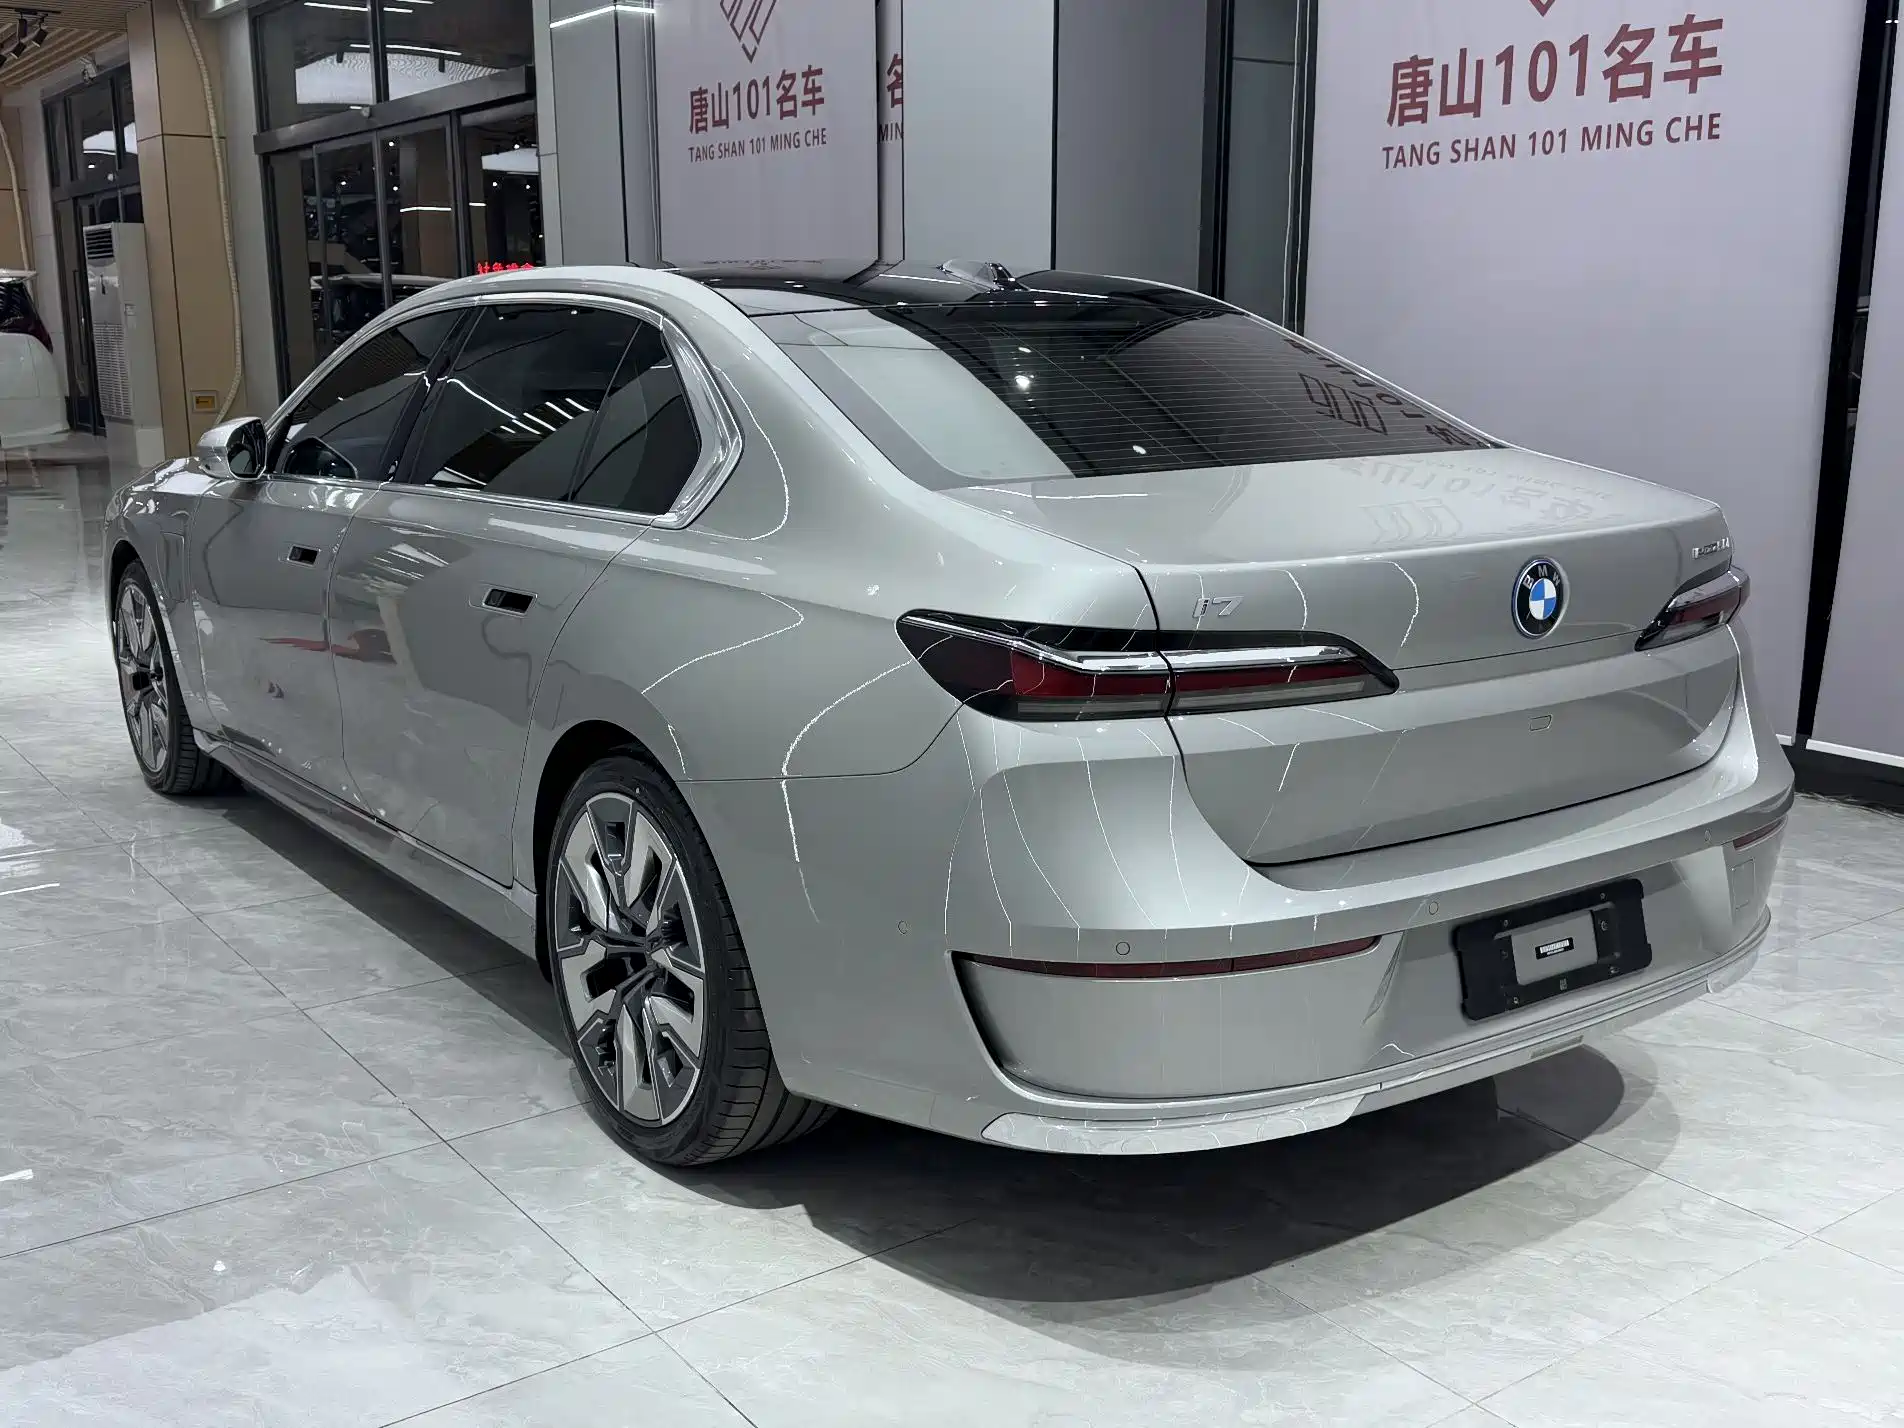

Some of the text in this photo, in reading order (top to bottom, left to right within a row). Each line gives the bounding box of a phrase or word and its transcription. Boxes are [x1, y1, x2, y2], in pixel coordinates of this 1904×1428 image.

[1386, 13, 1723, 127] 唐山101名车
[688, 65, 825, 134] 唐山101名车
[688, 127, 827, 163] TANG SHAN 101 MING CHE
[1382, 112, 1721, 169] TANG SHAN 101 MING CHE
[1522, 564, 1561, 589] BMW
[1192, 595, 1244, 618] i7
